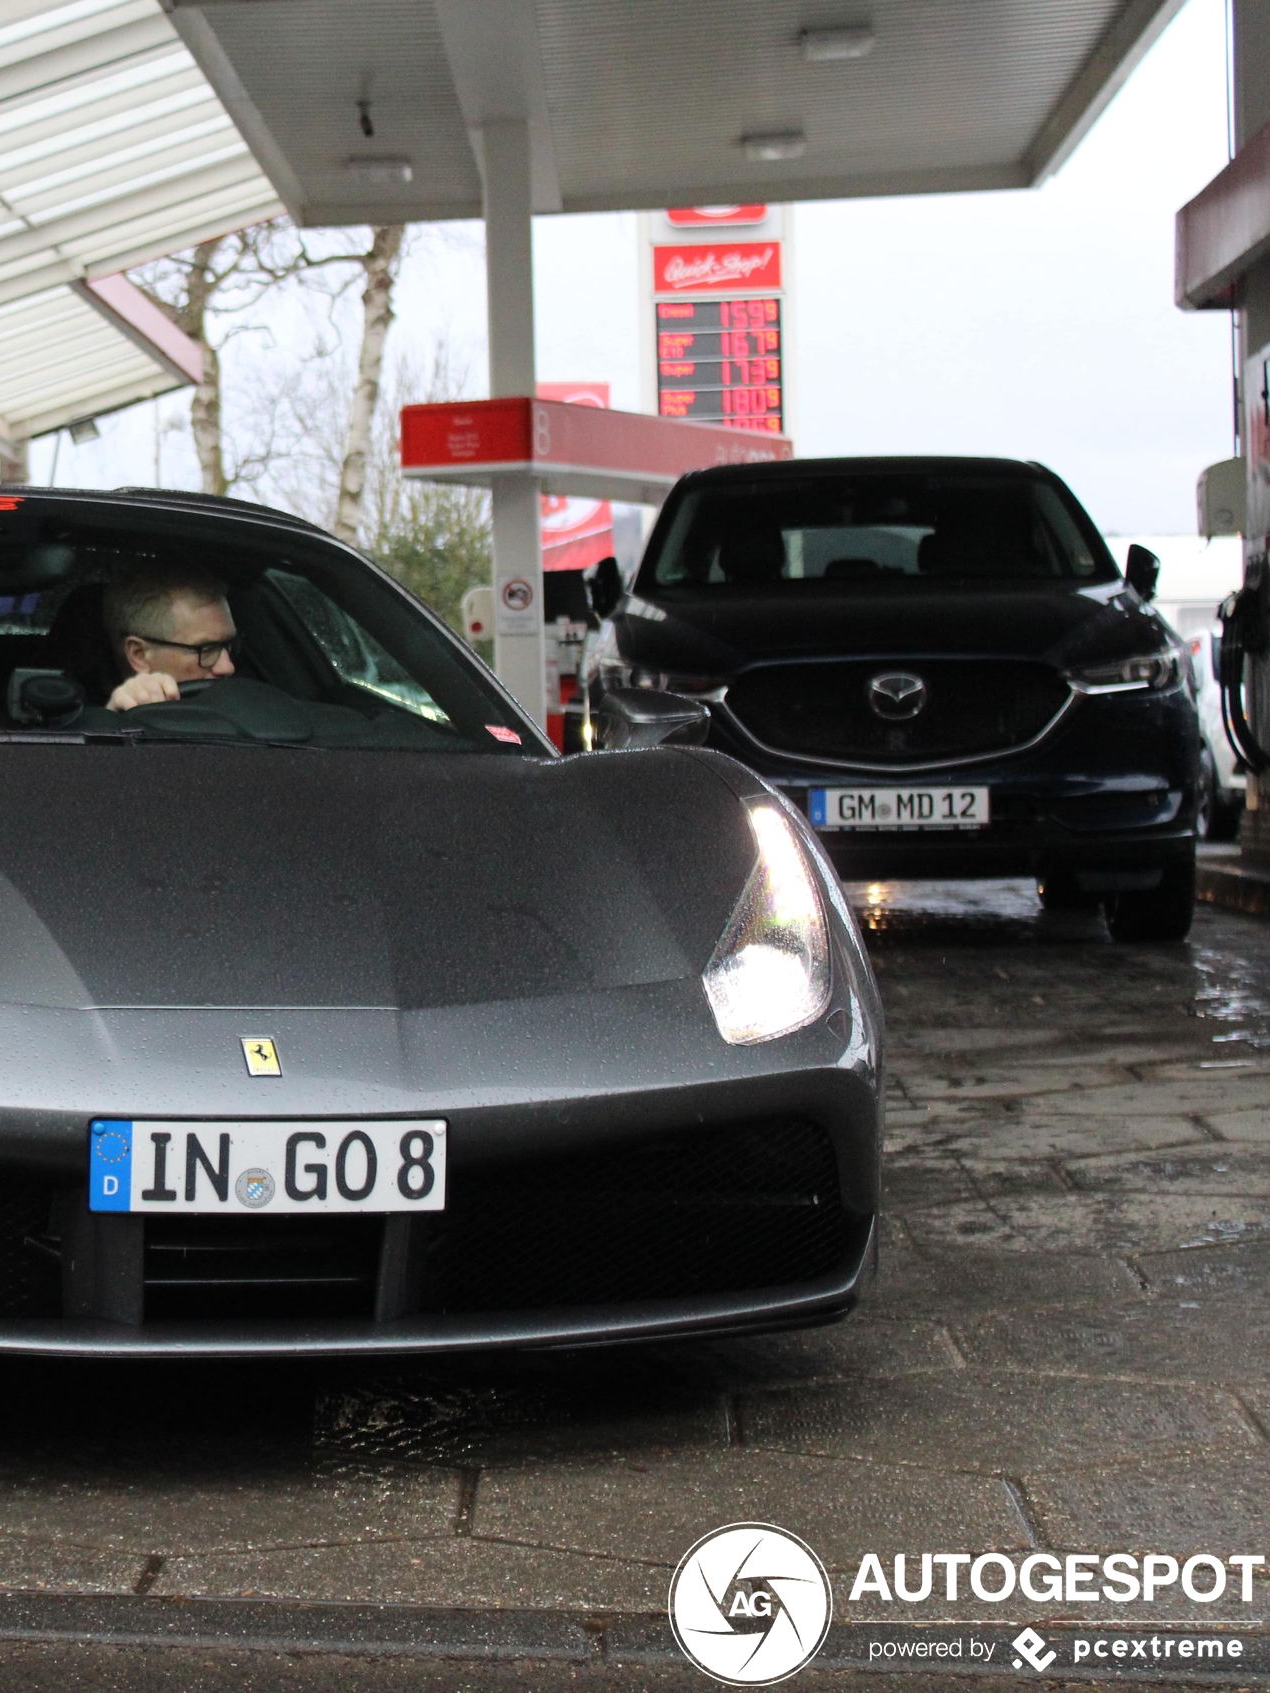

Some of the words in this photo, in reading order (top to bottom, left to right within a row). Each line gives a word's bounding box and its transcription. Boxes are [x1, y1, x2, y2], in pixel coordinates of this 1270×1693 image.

[659, 332, 694, 347] Super
[659, 345, 685, 359] E10
[660, 361, 695, 377] Super
[660, 389, 696, 405] Super
[661, 402, 689, 417] Plus
[536, 408, 551, 456] 8
[838, 794, 876, 821] GM
[896, 793, 934, 820] MD
[942, 792, 977, 819] 12
[141, 1131, 231, 1201] IN
[285, 1130, 378, 1202] GO
[396, 1129, 436, 1201] 8
[103, 1175, 119, 1195] D
